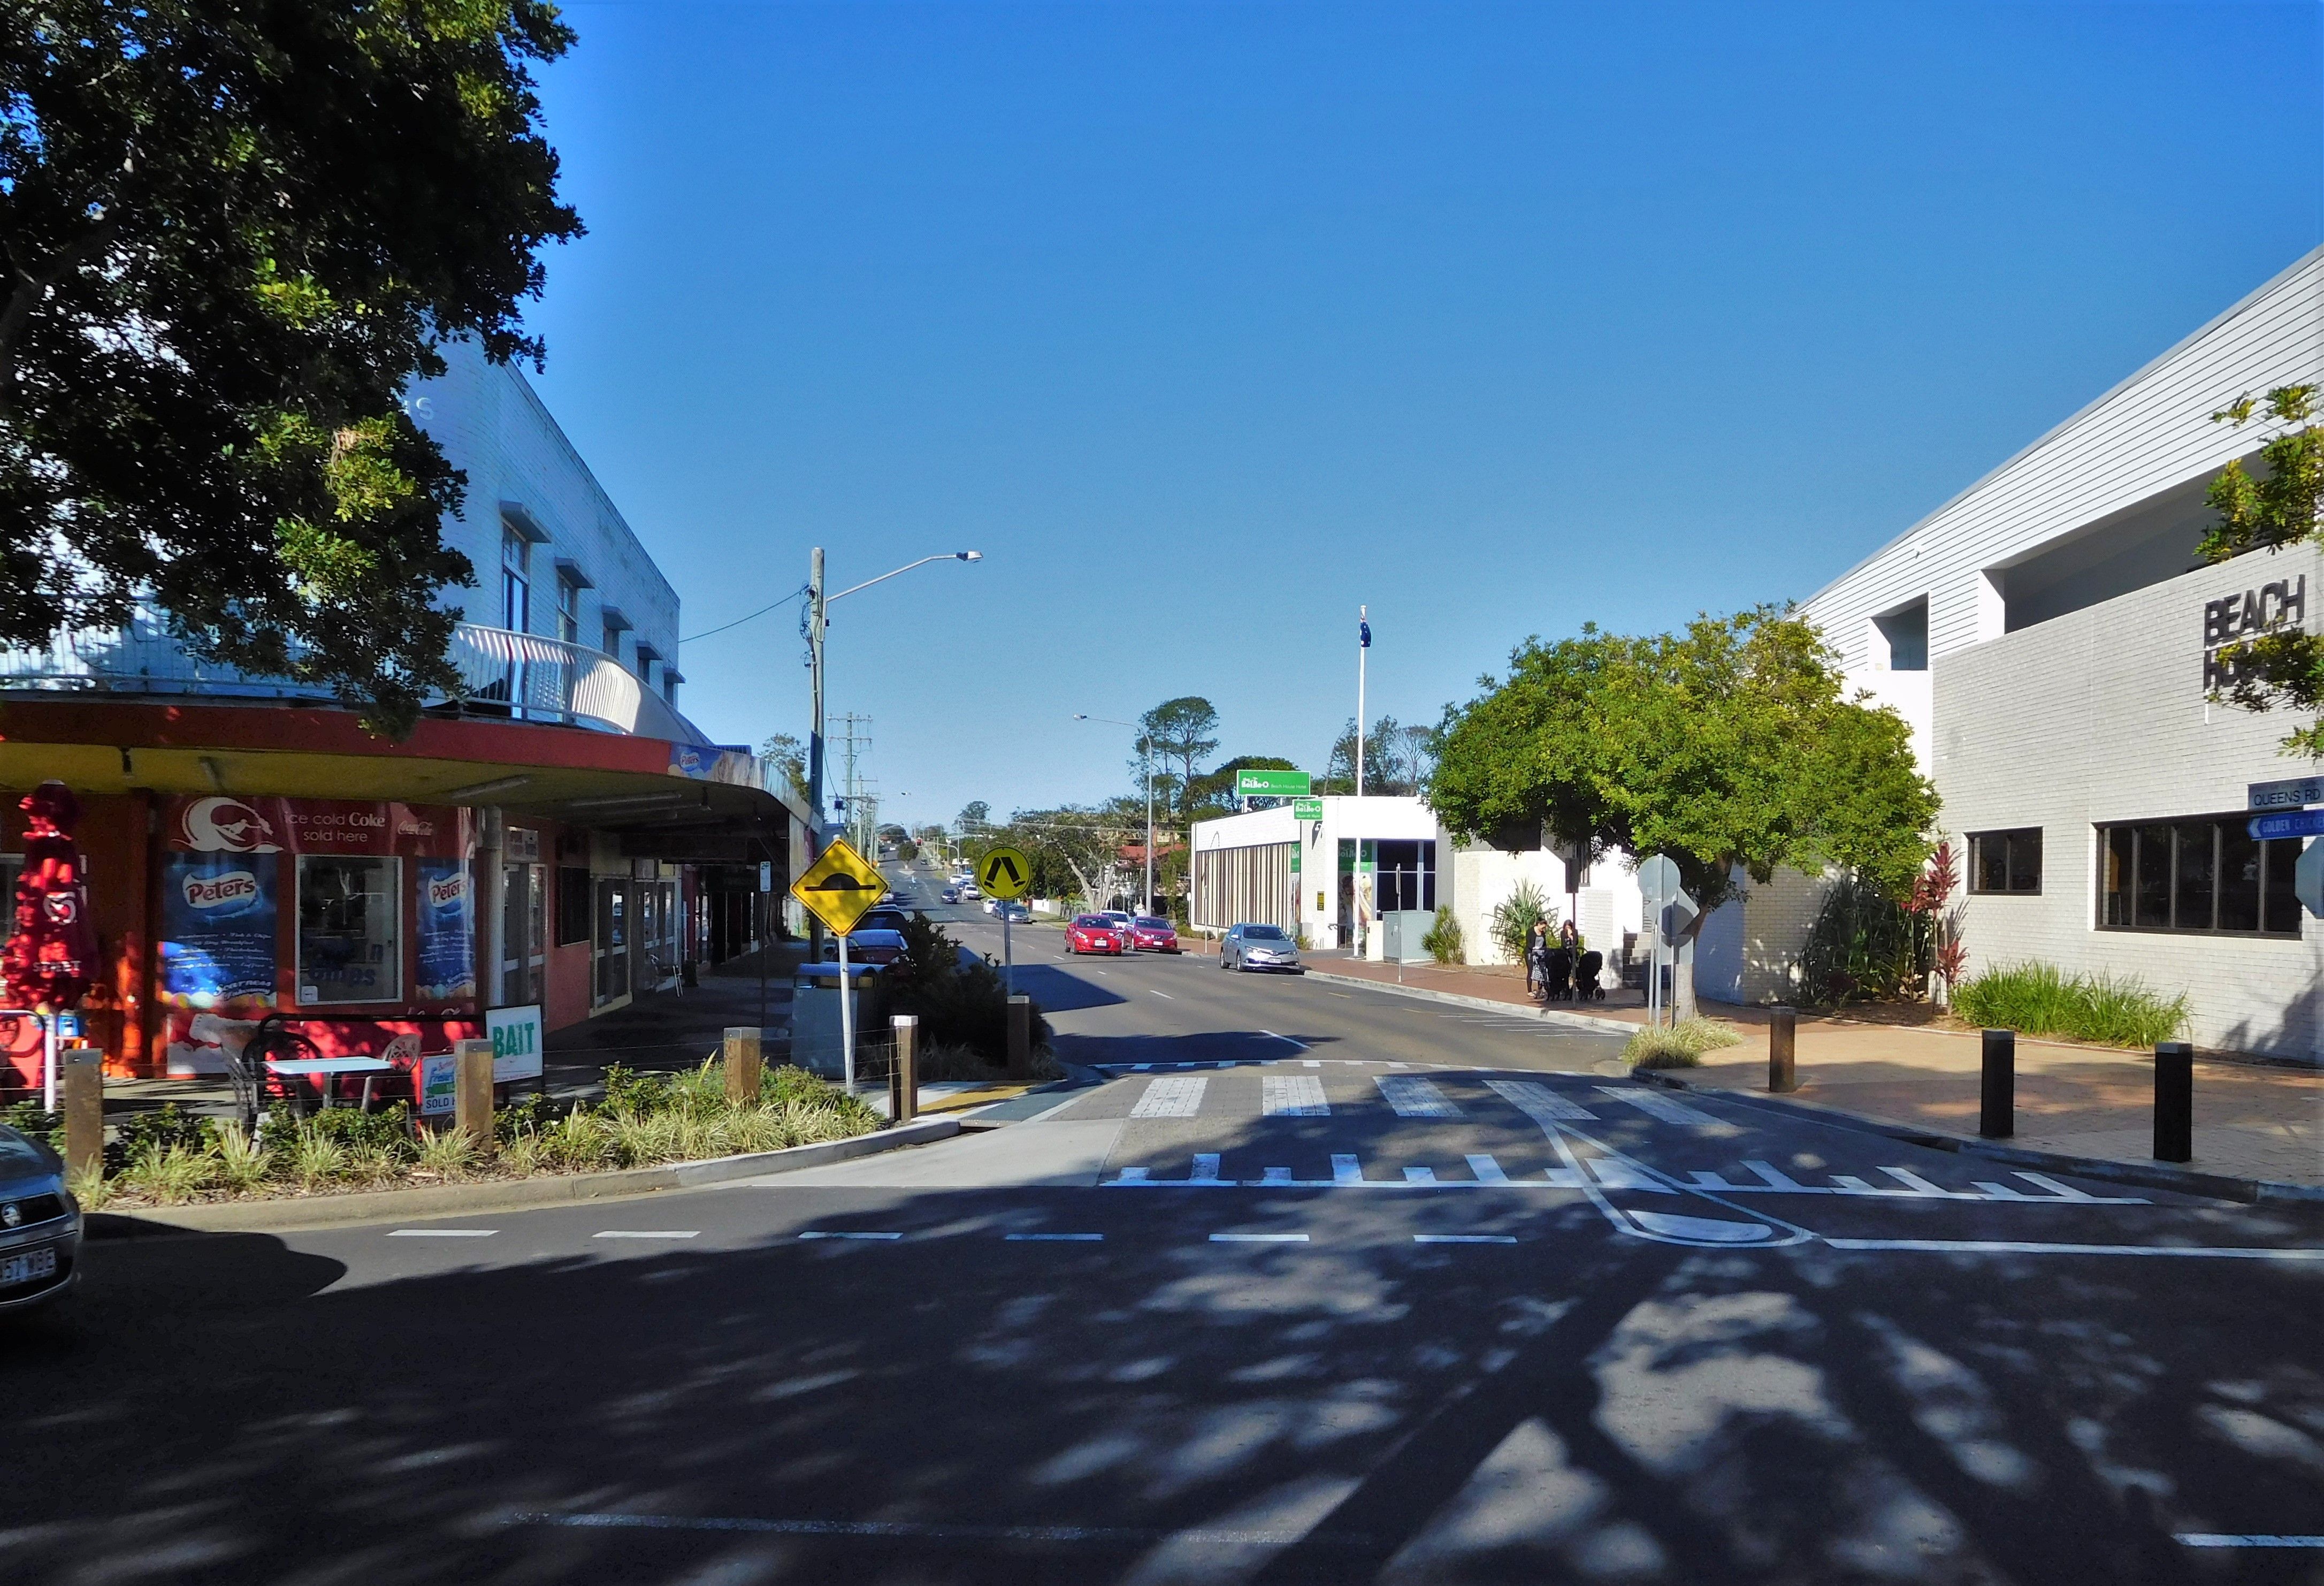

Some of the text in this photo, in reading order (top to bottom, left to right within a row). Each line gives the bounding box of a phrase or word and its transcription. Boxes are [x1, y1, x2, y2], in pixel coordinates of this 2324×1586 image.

[2204, 574, 2305, 641] BEACH
[2254, 789, 2321, 806] QUEENS RD
[313, 813, 345, 825] cold
[349, 812, 386, 827] Coke
[303, 830, 368, 842] sold here
[185, 878, 256, 904] Peters
[431, 880, 467, 904] Peters
[492, 1022, 534, 1059] BAIT
[426, 1097, 449, 1109] SOLD
